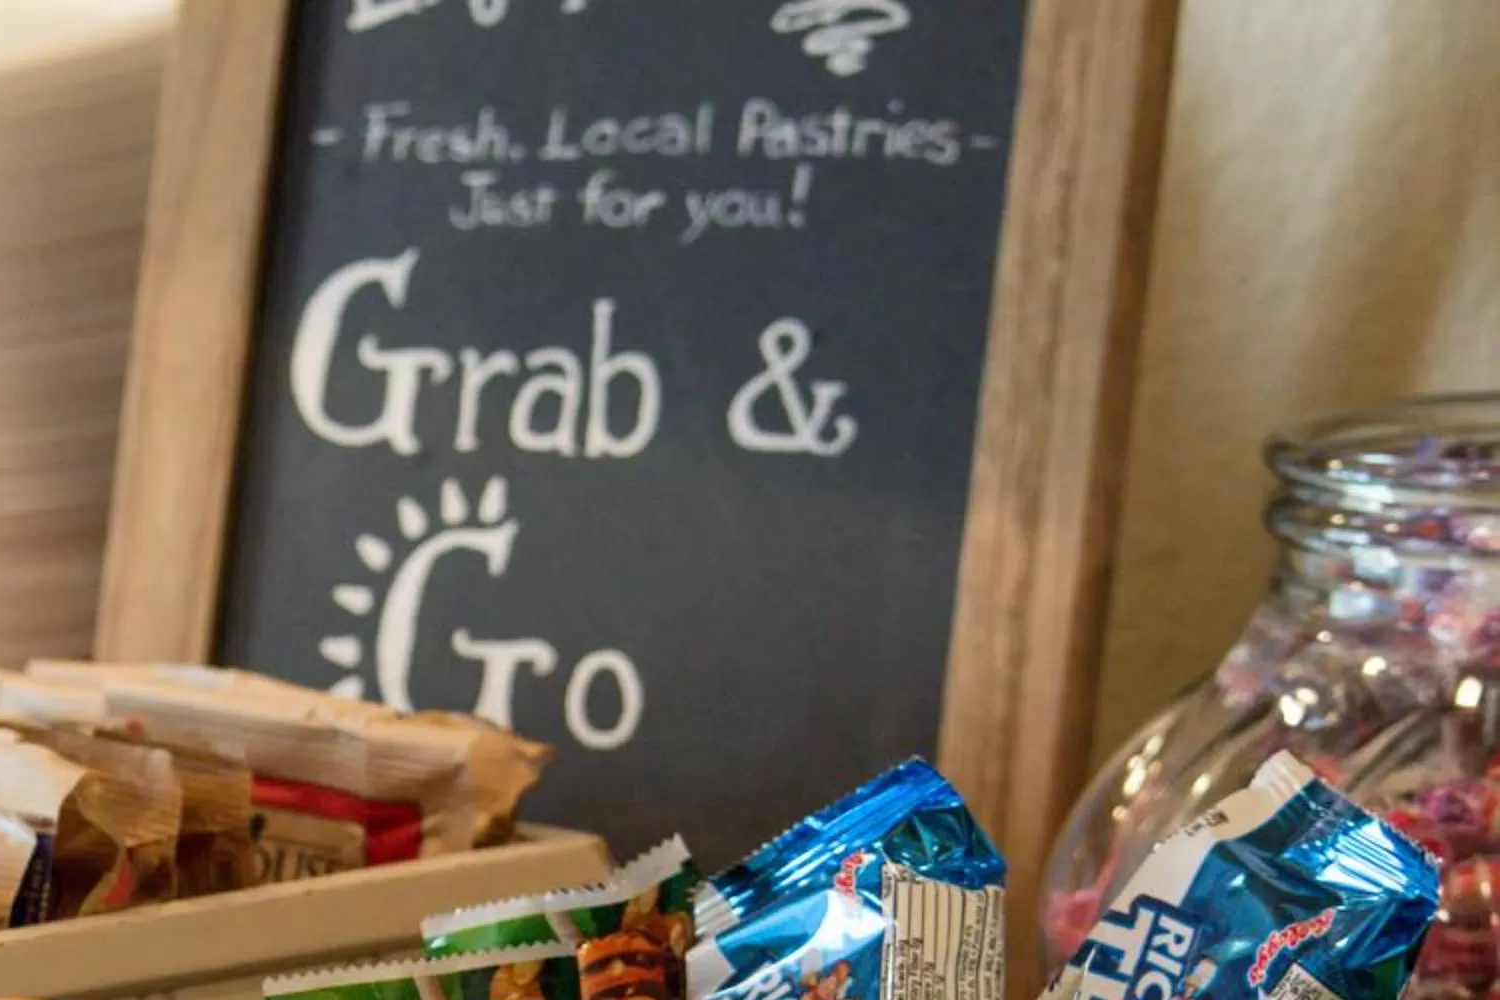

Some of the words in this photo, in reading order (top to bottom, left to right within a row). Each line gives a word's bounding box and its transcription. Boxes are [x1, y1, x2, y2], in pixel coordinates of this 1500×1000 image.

[448, 170, 556, 231] Just
[578, 169, 666, 228] for
[678, 161, 814, 245] you!
[537, 103, 713, 160] Local
[736, 96, 961, 166] Pastries
[291, 248, 661, 458] Grab
[727, 317, 858, 458] &
[375, 519, 645, 750] Go
